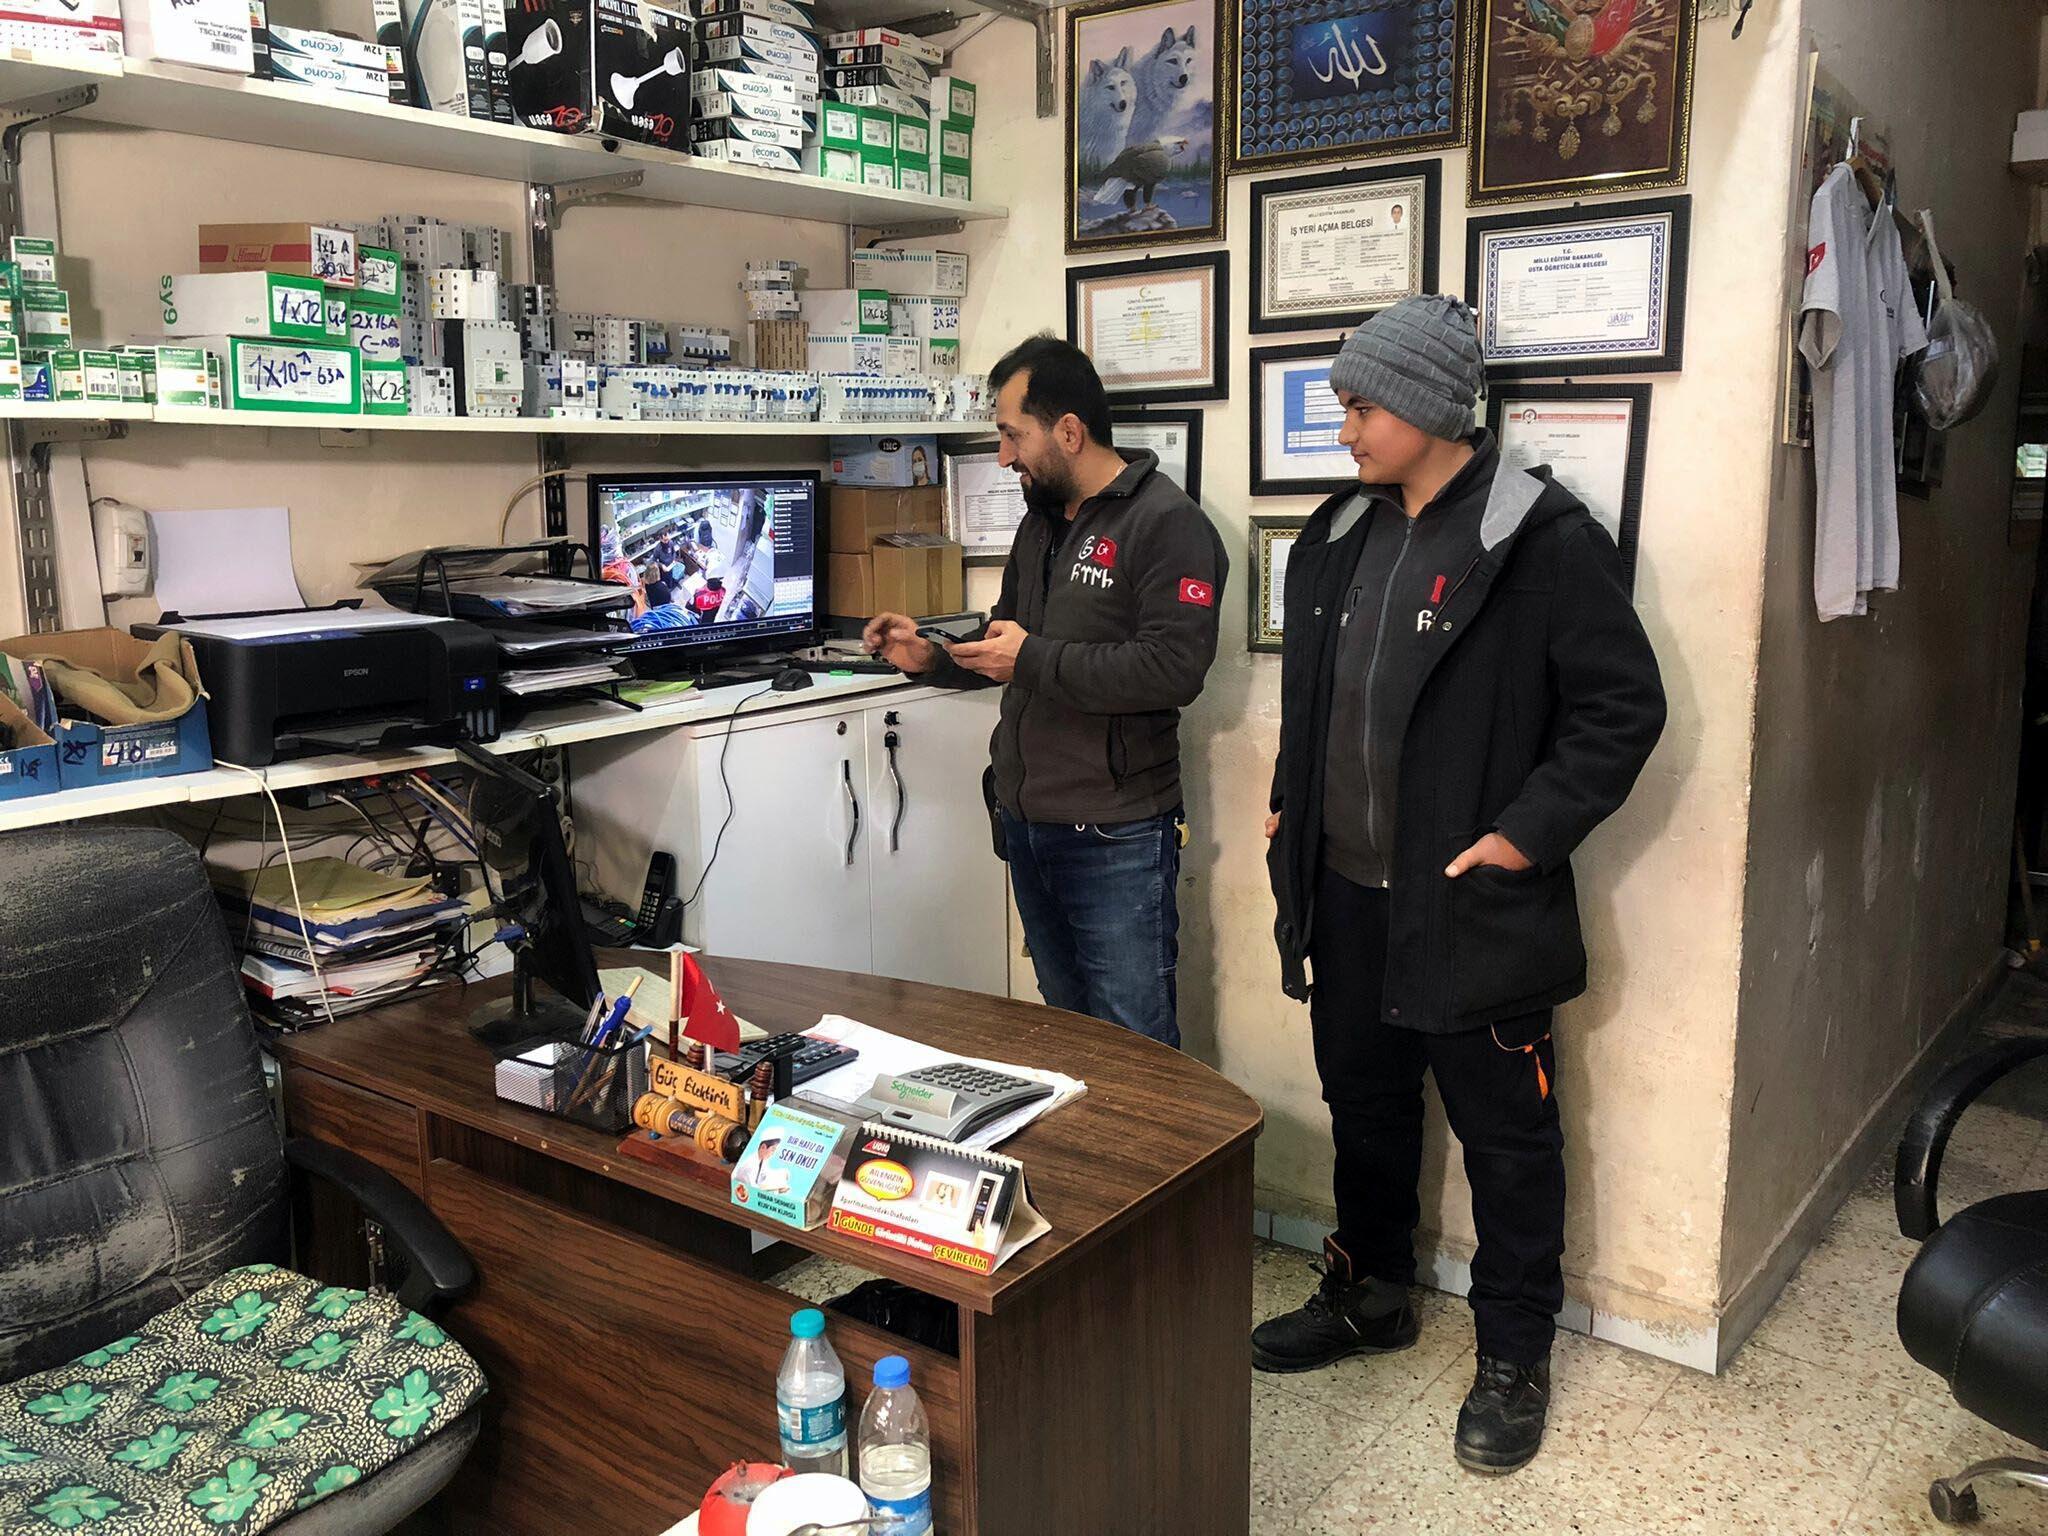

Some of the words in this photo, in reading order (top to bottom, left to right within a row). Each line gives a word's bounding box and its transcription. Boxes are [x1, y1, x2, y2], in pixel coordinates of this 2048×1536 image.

[746, 27, 758, 36] 12W
[363, 45, 382, 55] 12W
[366, 72, 384, 82] 12W
[1290, 226, 1298, 237] İŞ
[1299, 223, 1316, 235] YERİ
[1317, 221, 1339, 233] AÇMA
[1341, 216, 1374, 230] BELGESİ
[343, 668, 369, 677] EPSON
[655, 1063, 678, 1096] Güç
[890, 1080, 934, 1100] Schneider
[779, 1148, 795, 1163] SEN
[796, 1153, 818, 1169] OKUT
[833, 1211, 841, 1225] 1
[841, 1216, 875, 1234] GÜNDE
[933, 1244, 989, 1270] ÇEVİRELİM
